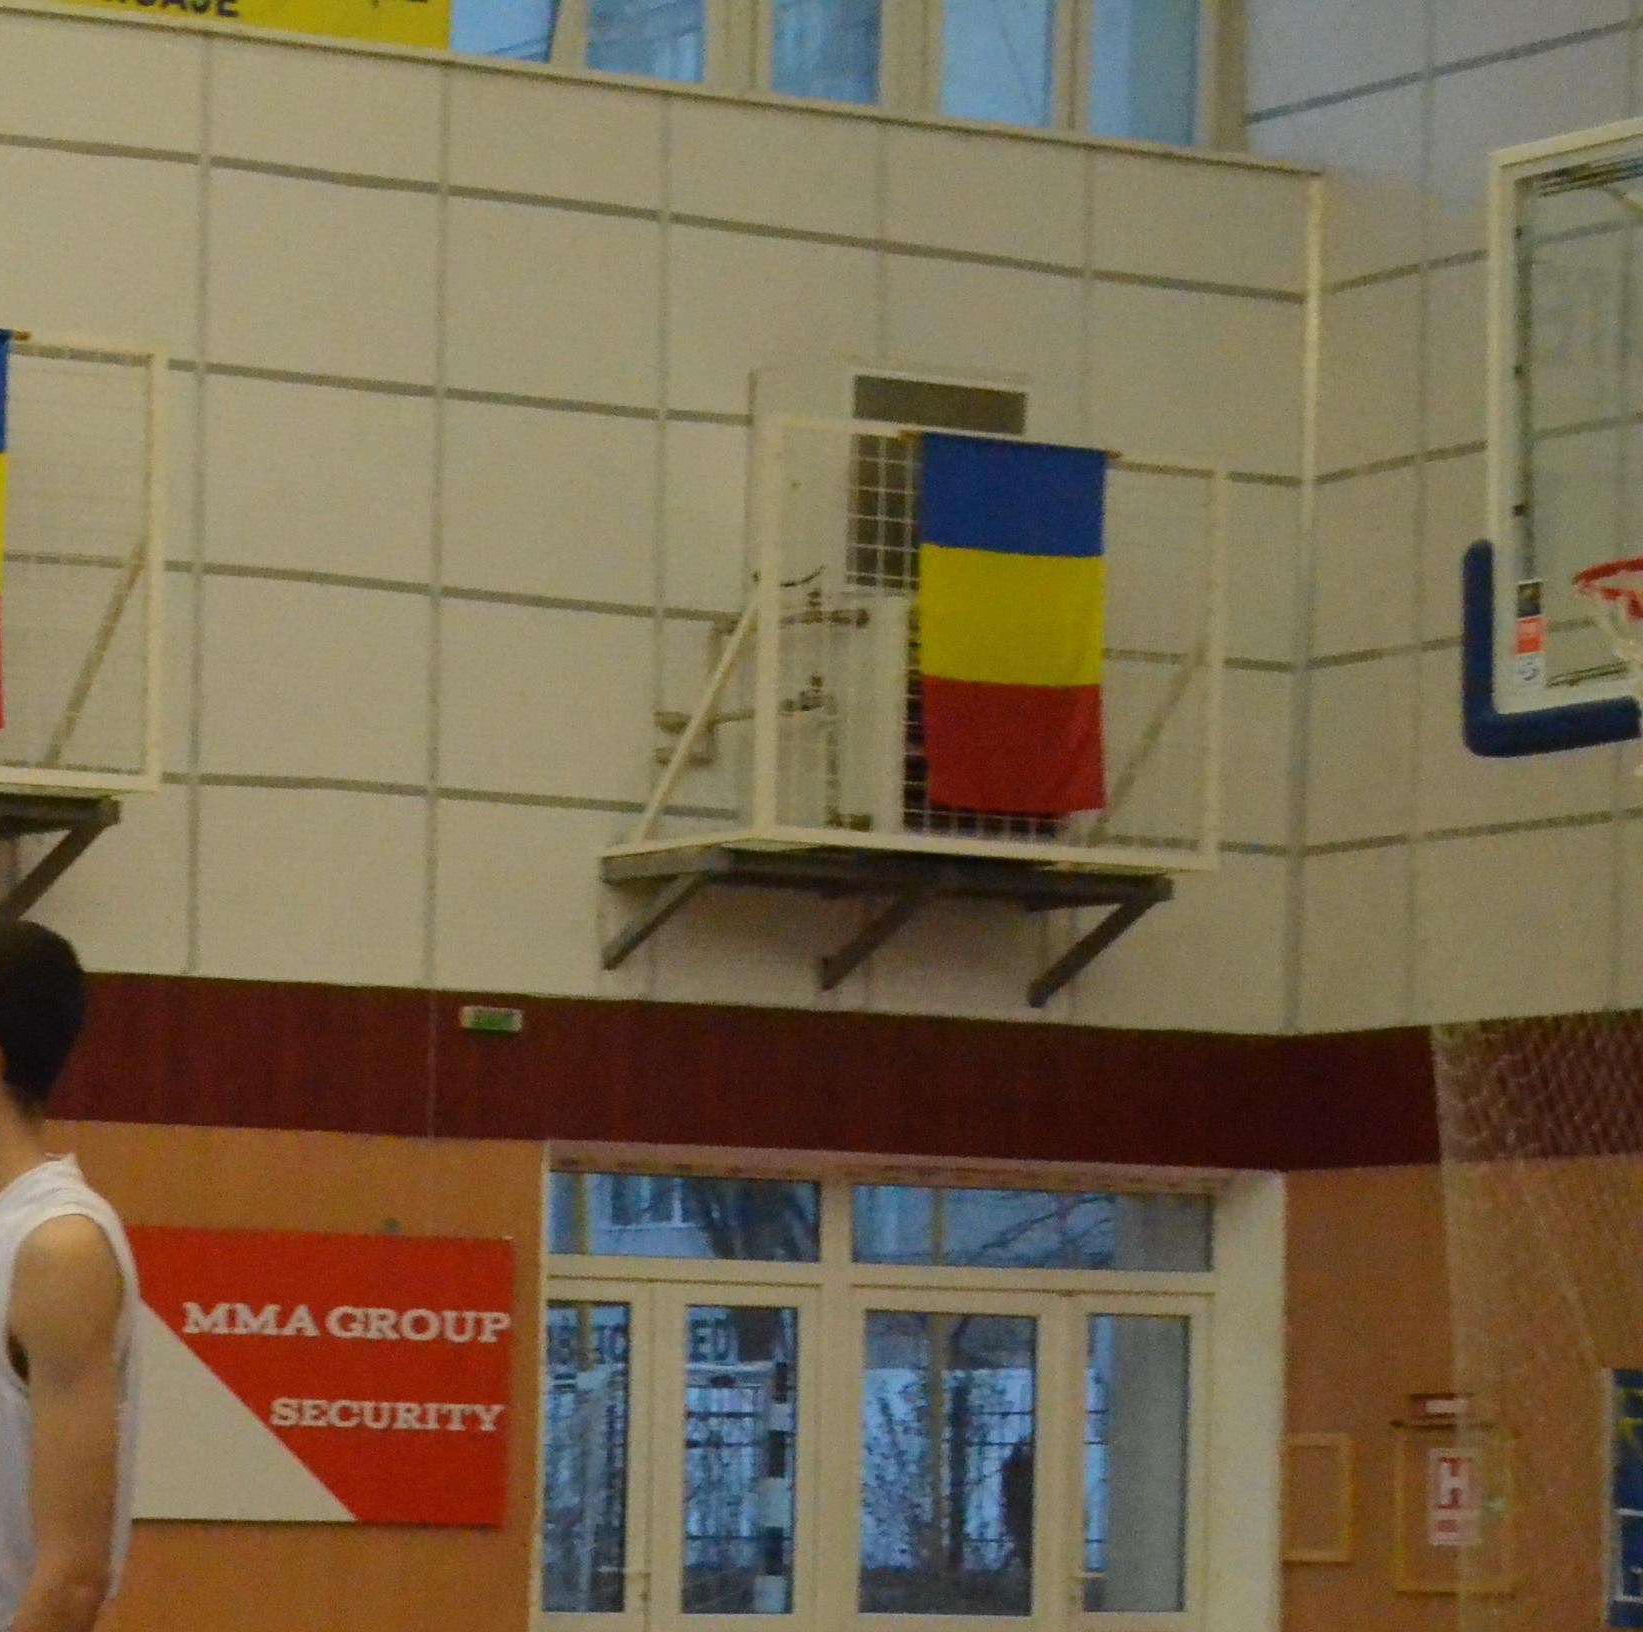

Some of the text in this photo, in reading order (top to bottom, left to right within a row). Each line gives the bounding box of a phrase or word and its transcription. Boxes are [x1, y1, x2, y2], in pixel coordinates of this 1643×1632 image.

[182, 1302, 512, 1344] MMA GROUP
[269, 1398, 503, 1432] SECURITY
